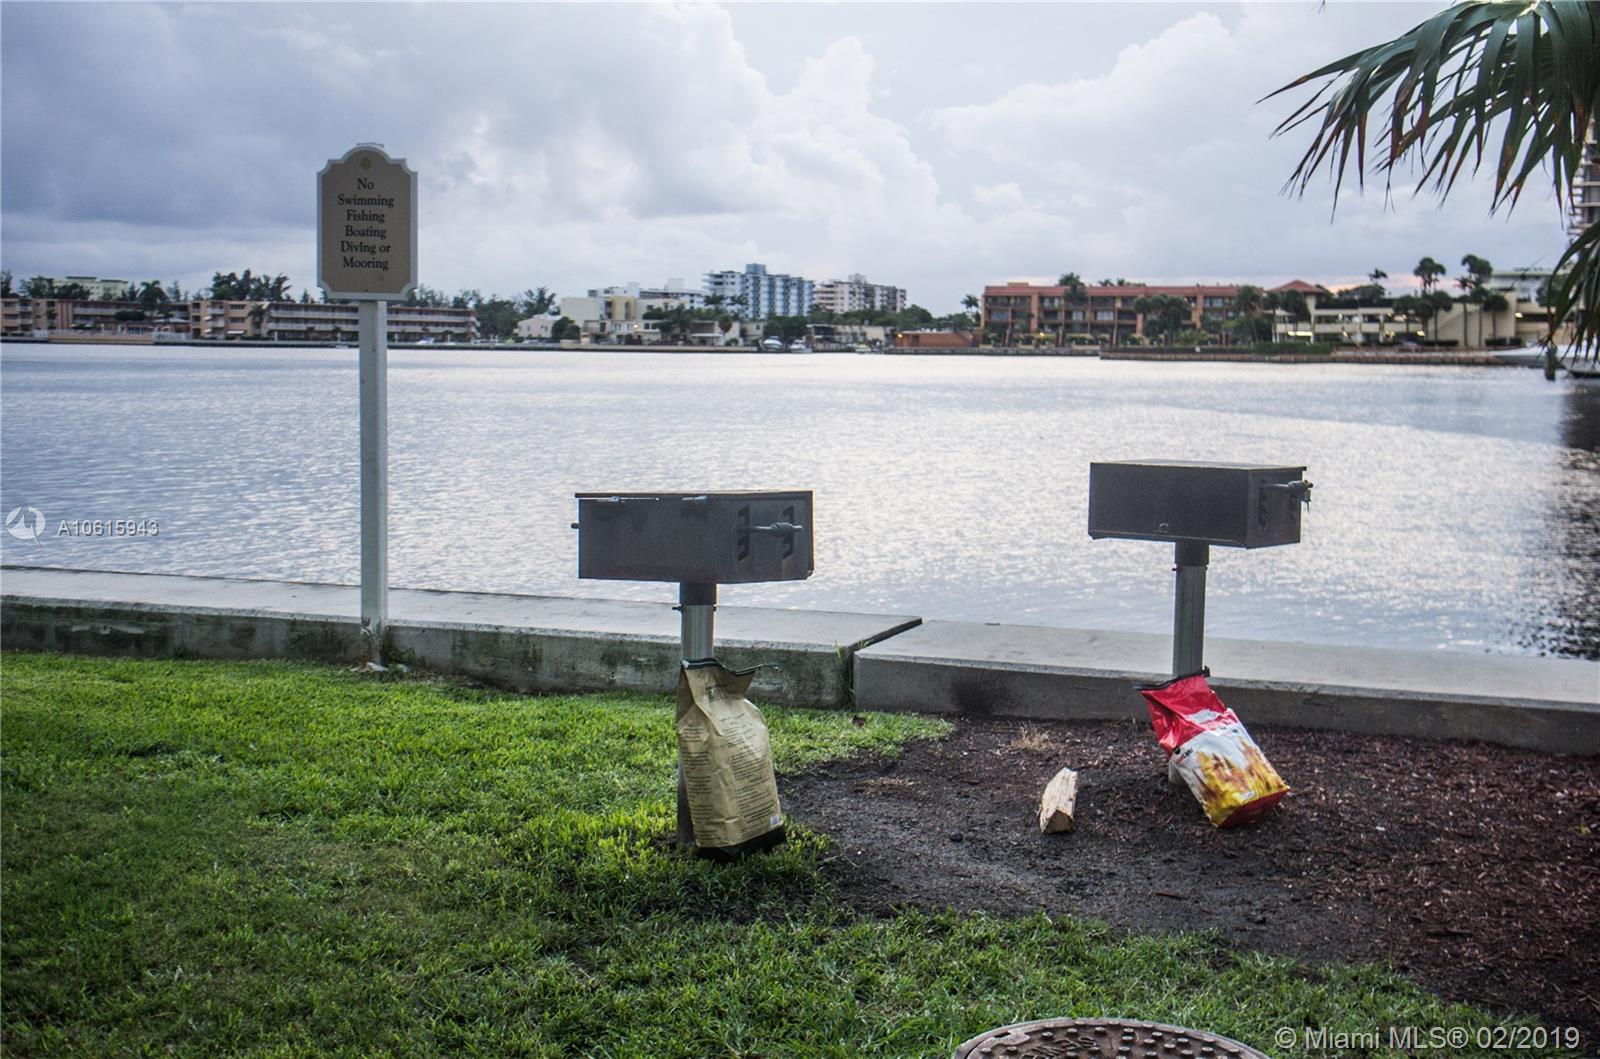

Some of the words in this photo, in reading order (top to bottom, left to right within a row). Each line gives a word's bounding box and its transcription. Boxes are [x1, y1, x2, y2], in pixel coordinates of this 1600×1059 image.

[357, 178, 374, 190] No
[337, 193, 394, 208] Swimming
[346, 209, 385, 223] Fishing
[345, 225, 386, 239] Boating
[340, 240, 376, 255] Diving
[378, 244, 391, 254] or
[343, 256, 389, 271] Mooring
